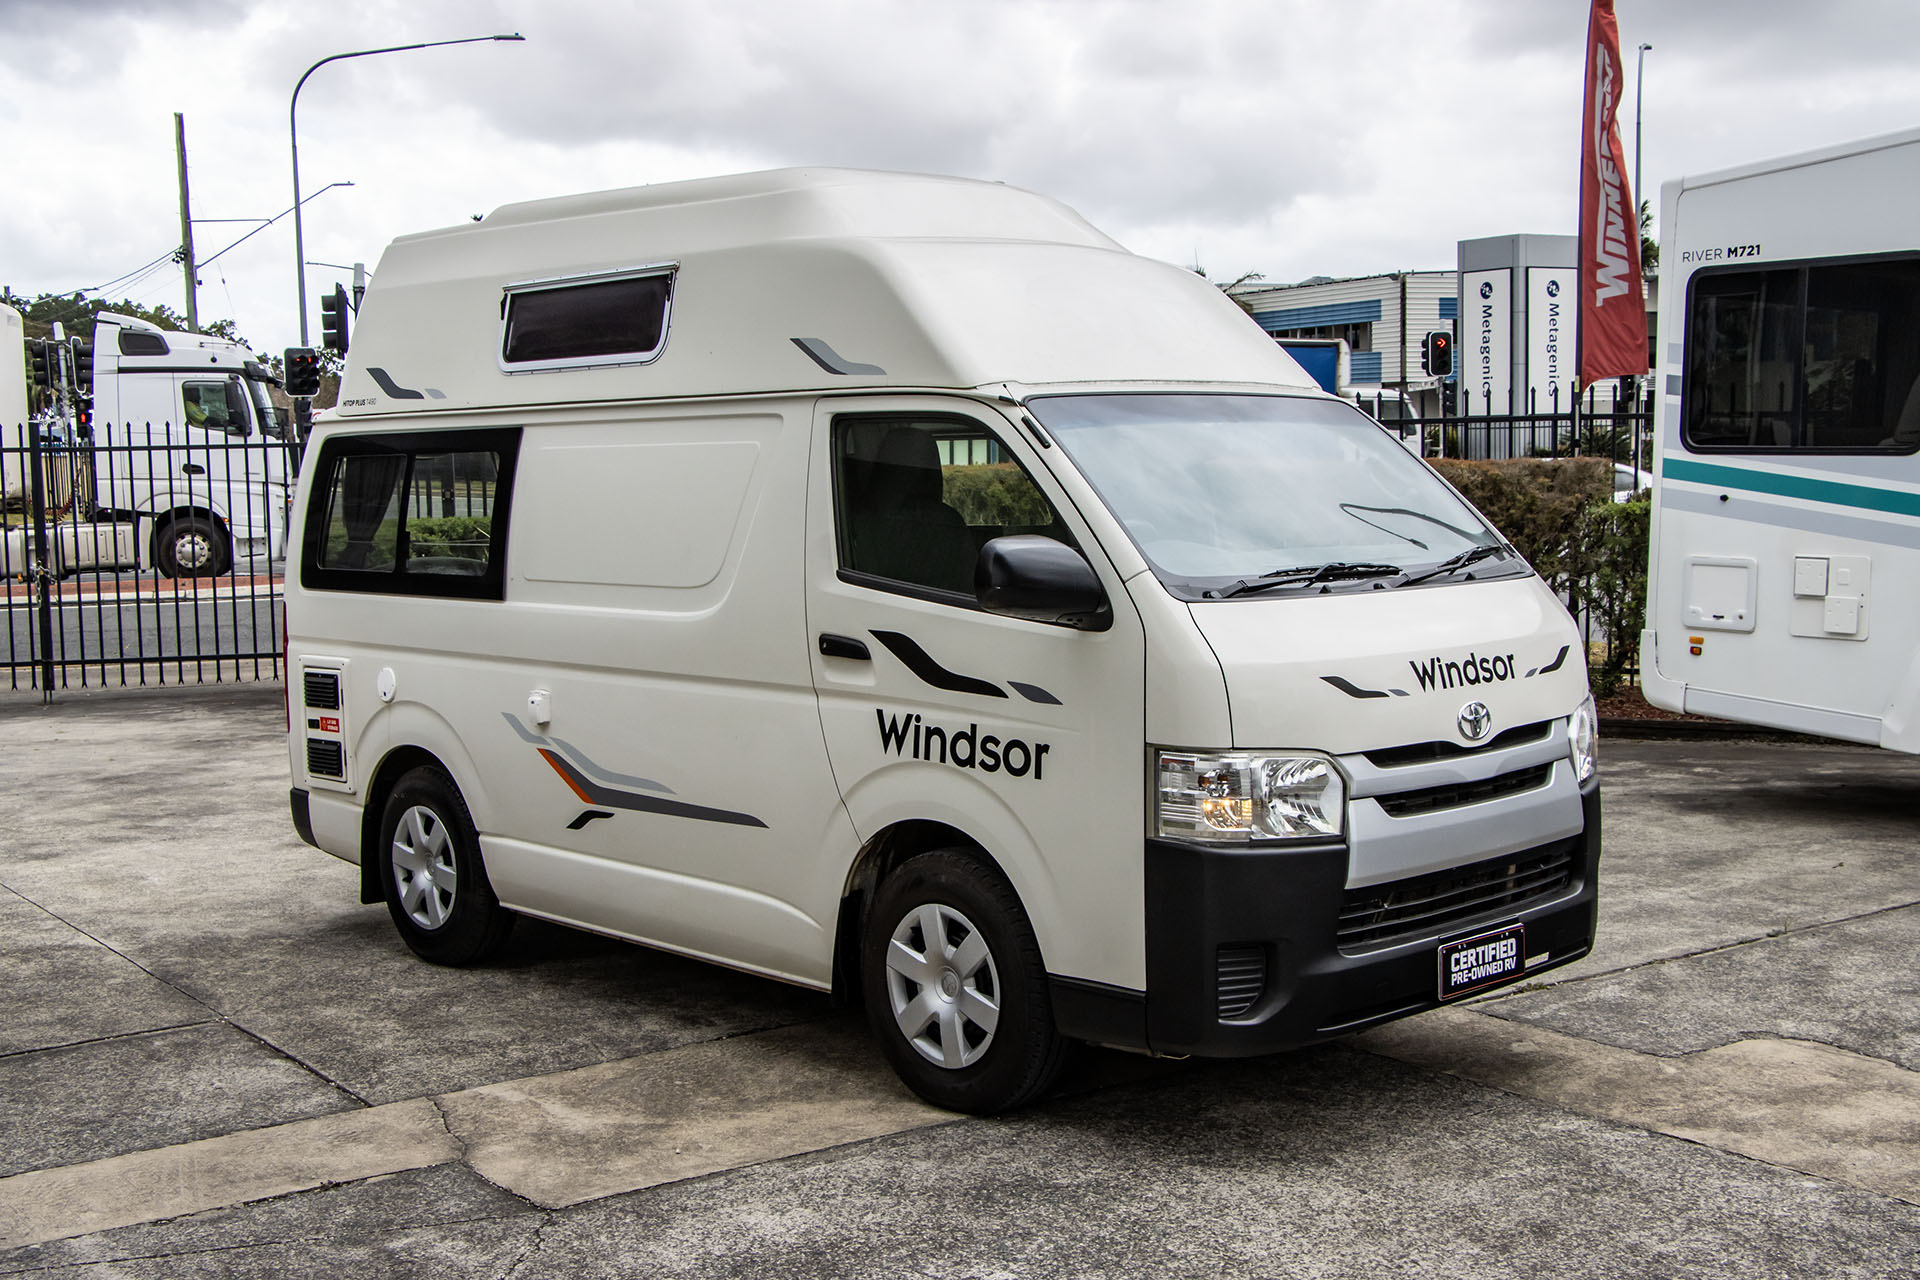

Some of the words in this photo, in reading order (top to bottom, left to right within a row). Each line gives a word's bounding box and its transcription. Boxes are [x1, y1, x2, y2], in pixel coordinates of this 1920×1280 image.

[1596, 42, 1630, 307] WINNE
[1682, 248, 1723, 263] RIVER
[1727, 244, 1761, 259] M721
[1480, 304, 1493, 399] Metagenics
[1546, 303, 1560, 398] Metagenics
[1409, 652, 1515, 693] Windsor
[876, 708, 1051, 780] Windsor
[1451, 938, 1517, 973] CERTIFIED
[1451, 960, 1504, 987] PRE-OWNED
[1504, 956, 1517, 971] RV
